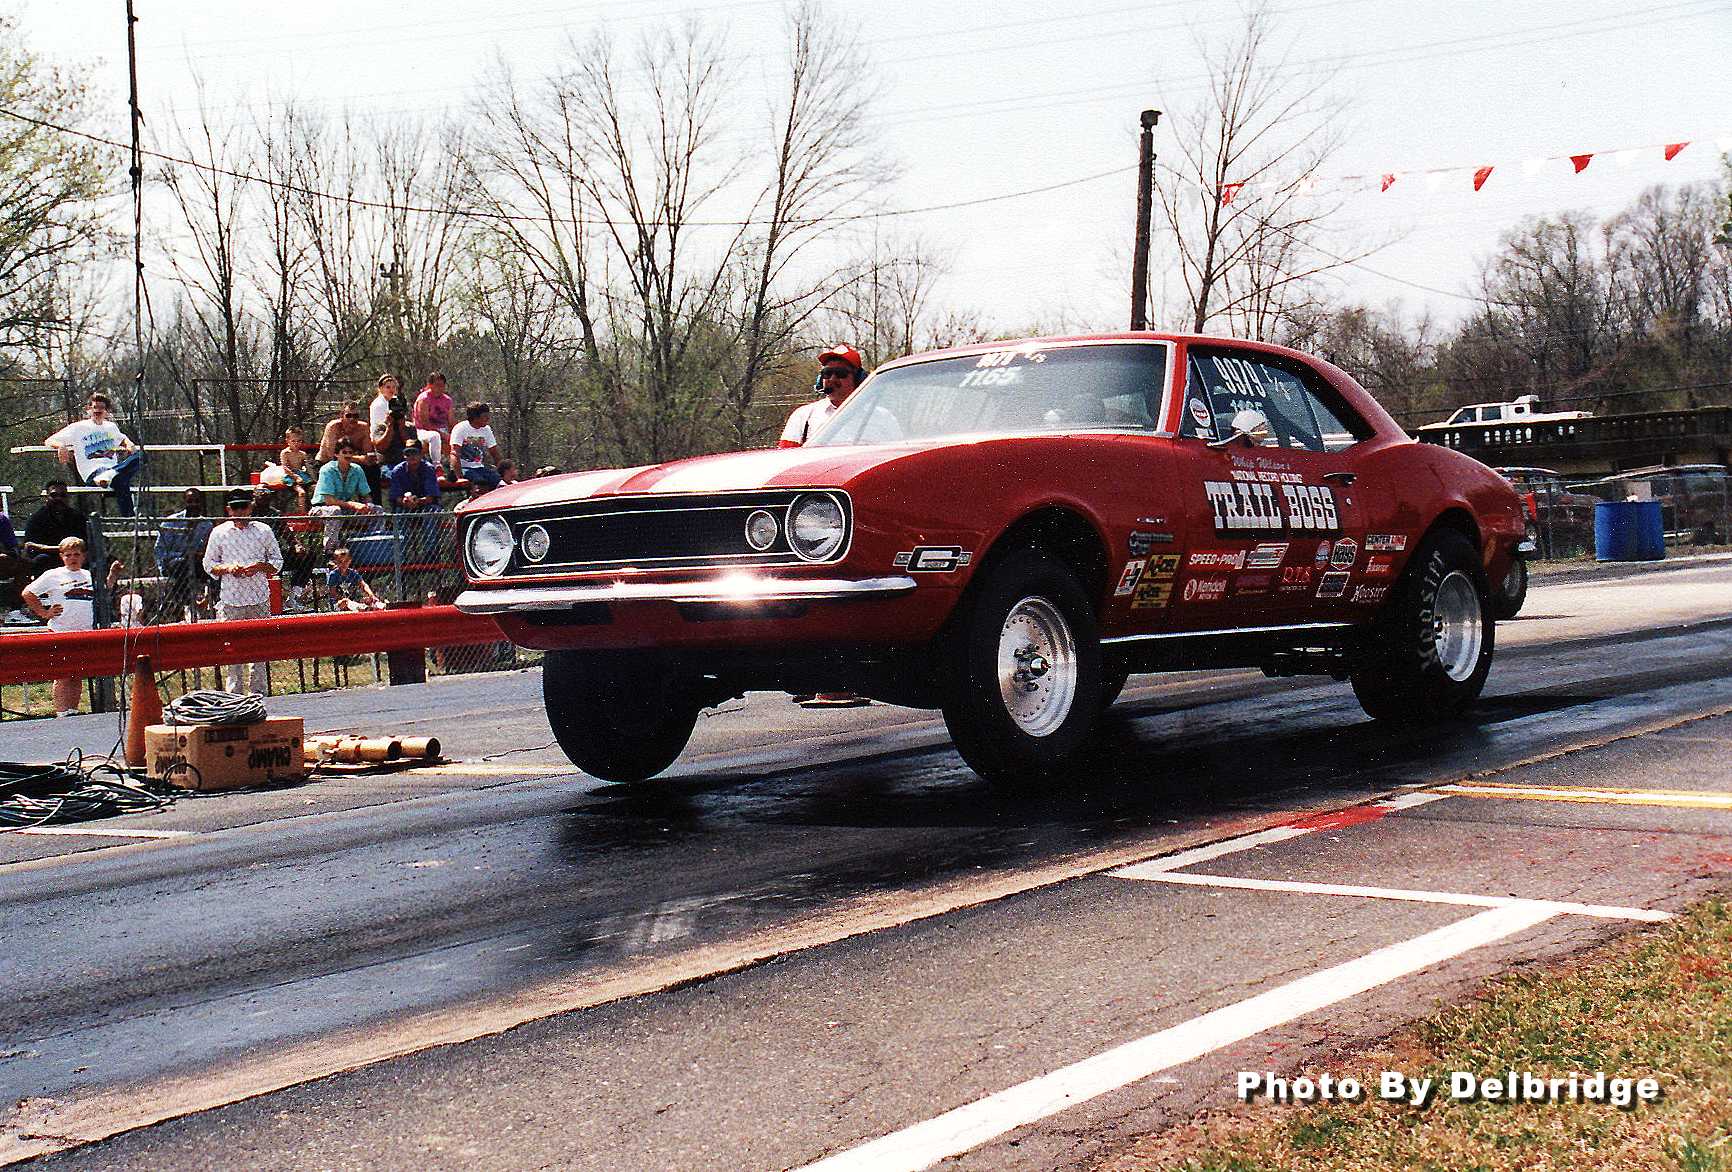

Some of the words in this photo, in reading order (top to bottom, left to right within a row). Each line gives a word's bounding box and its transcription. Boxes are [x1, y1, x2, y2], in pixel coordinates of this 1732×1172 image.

[1212, 355, 1266, 398] 9979
[1204, 481, 1283, 529] TRAIL
[1281, 484, 1338, 530] BOSS
[1197, 579, 1227, 593] Kendall
